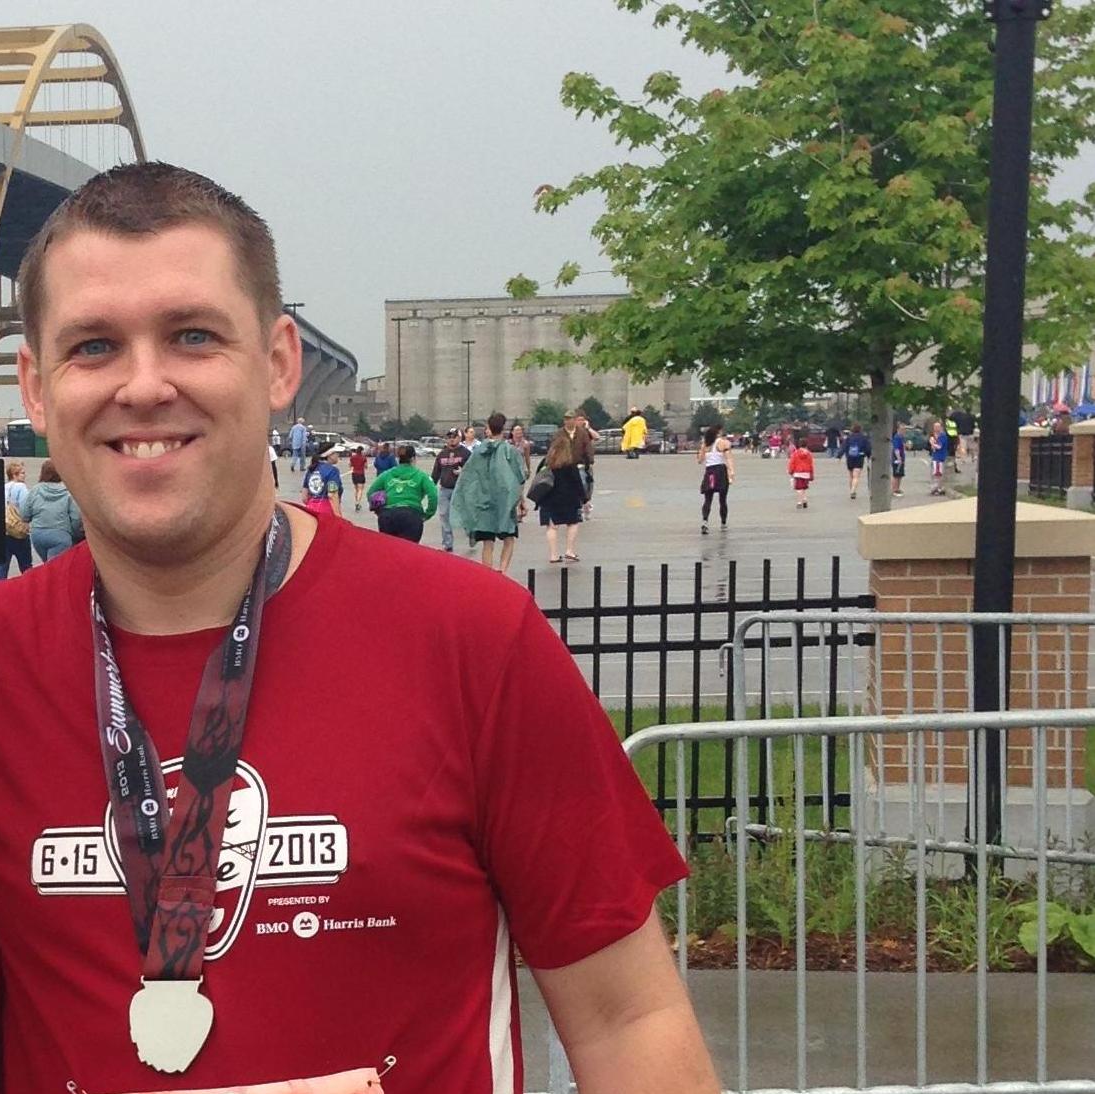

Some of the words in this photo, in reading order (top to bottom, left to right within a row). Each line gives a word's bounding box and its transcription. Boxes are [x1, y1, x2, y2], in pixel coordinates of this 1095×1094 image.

[116, 760, 130, 797] 2013
[268, 832, 337, 868] 2013
[267, 896, 317, 906] PRESENTED
[318, 895, 330, 904] BY
[256, 921, 290, 935] BMO
[323, 918, 365, 931] Harris
[367, 916, 397, 928] Bank
